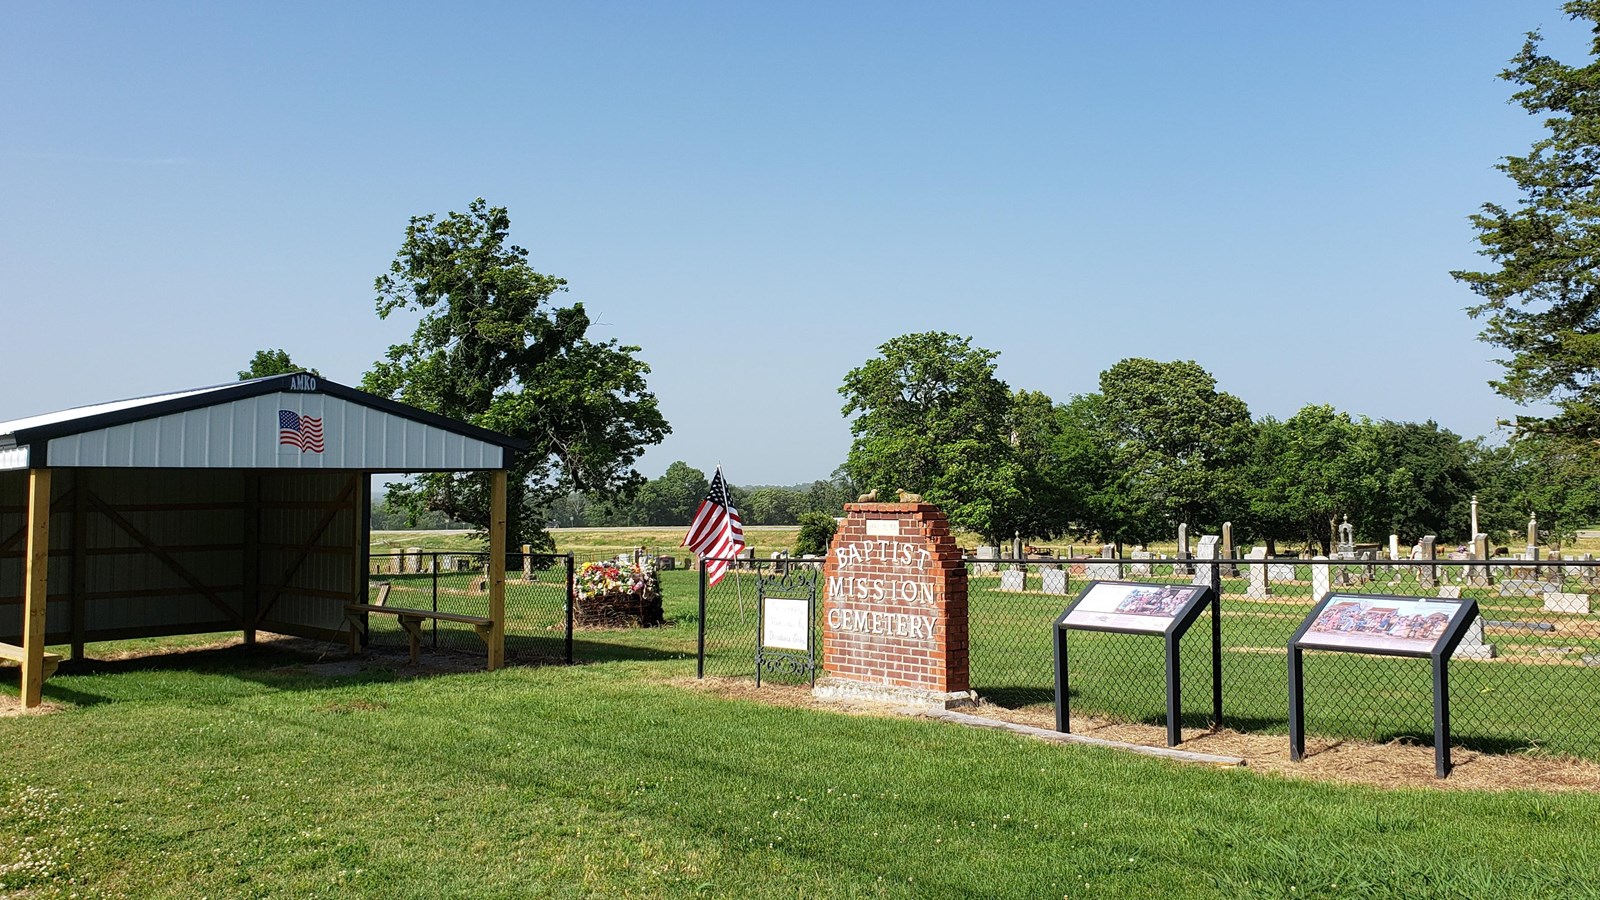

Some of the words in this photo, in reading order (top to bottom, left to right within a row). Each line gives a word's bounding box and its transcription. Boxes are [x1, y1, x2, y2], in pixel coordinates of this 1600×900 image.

[290, 374, 317, 391] AMKO
[835, 539, 930, 571] BAPTIST
[829, 576, 935, 605] MISSION
[827, 608, 938, 639] CEMETERY
